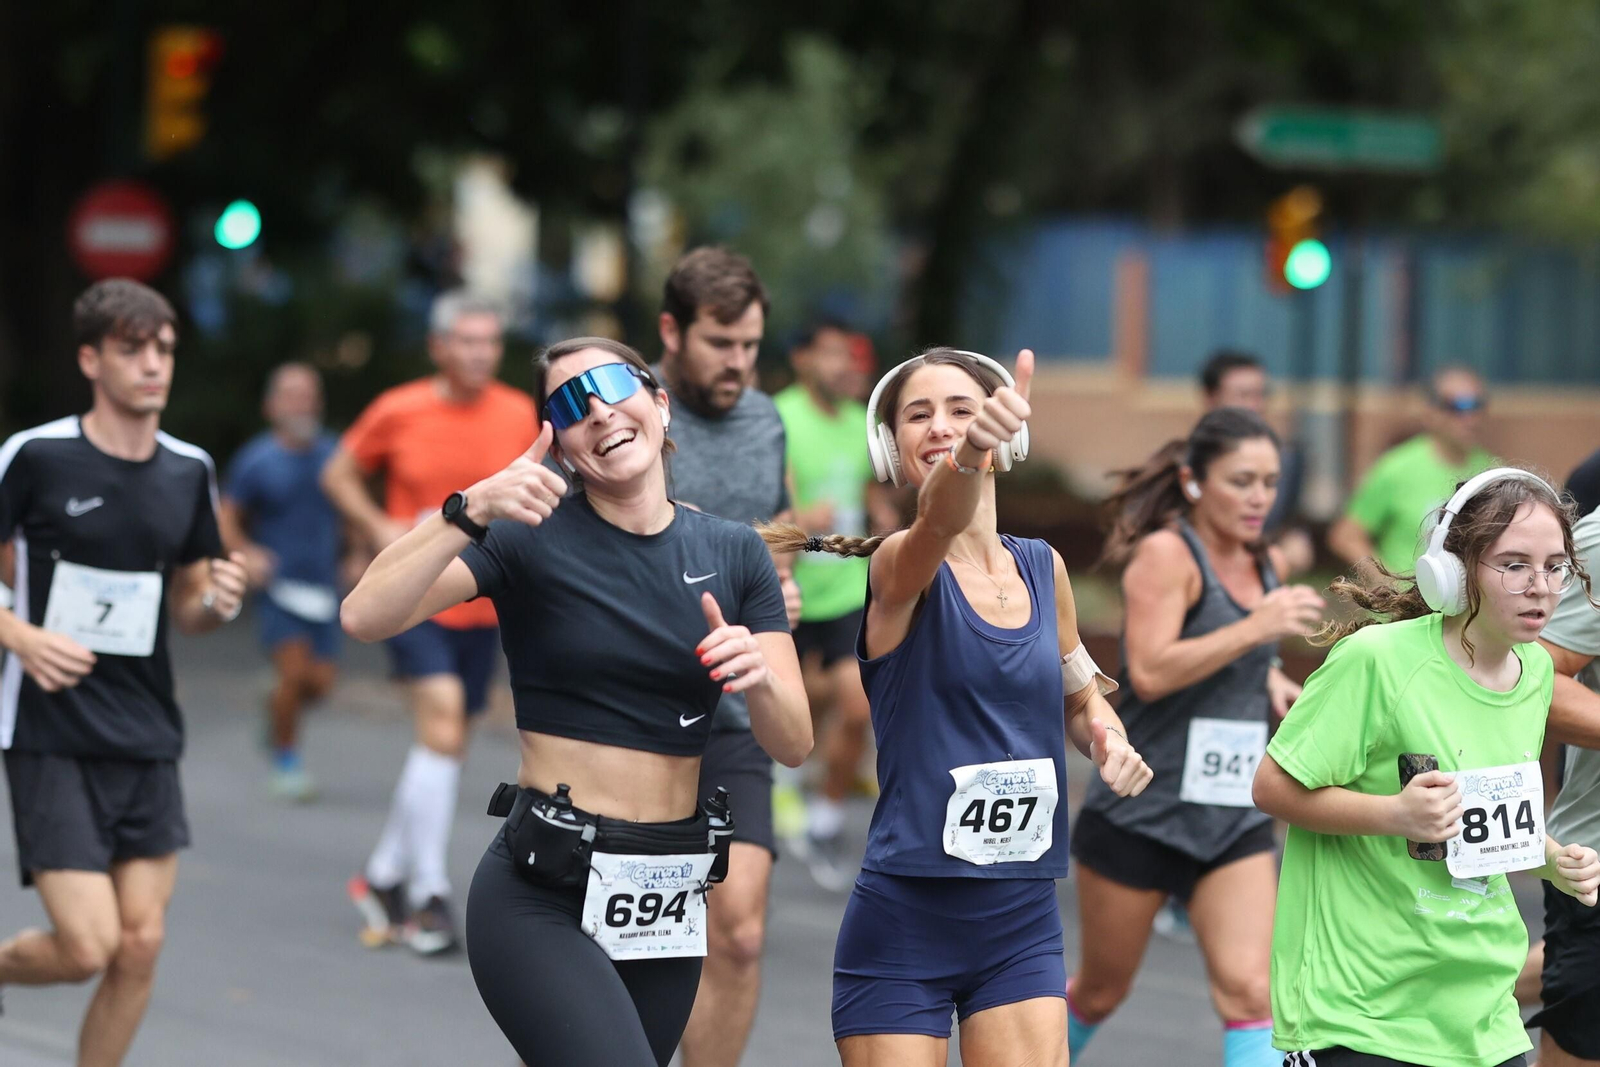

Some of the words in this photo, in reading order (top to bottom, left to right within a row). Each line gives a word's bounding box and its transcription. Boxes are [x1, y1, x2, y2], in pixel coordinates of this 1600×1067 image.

[95, 599, 113, 623] 7
[959, 796, 1038, 833] 467
[1462, 799, 1535, 844] 814
[605, 890, 689, 928] 694
